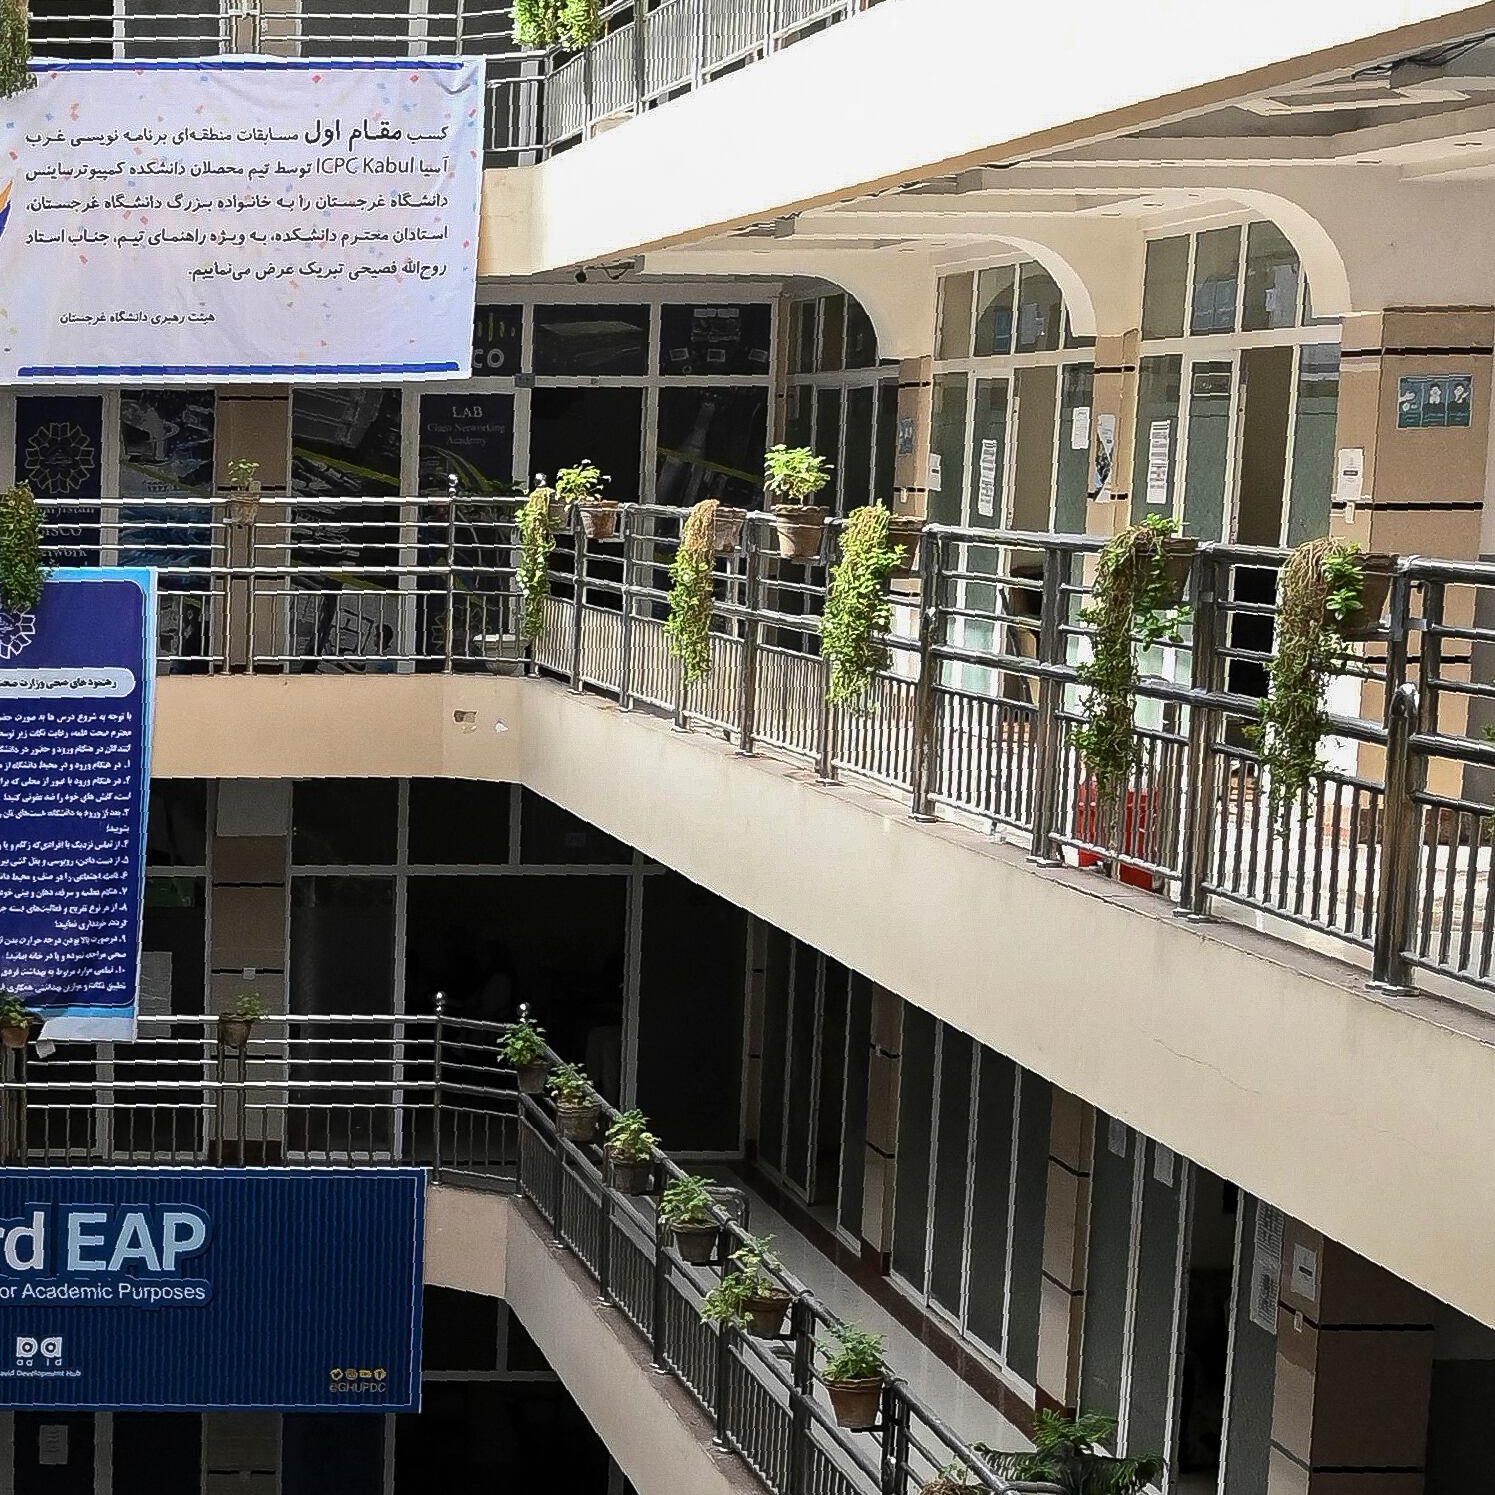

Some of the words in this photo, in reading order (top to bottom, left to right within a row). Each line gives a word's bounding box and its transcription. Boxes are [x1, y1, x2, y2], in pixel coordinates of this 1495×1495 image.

[26, 130, 65, 146] غرب
[71, 130, 118, 147] نویسی
[123, 128, 167, 149] برنامه
[237, 128, 298, 145] مسابقات
[305, 119, 340, 147] اول
[349, 119, 401, 152] مقام
[407, 126, 448, 144] کسب
[130, 162, 185, 175] دانشکده
[191, 161, 243, 177] محصلان
[248, 163, 270, 181] تیم
[274, 161, 312, 178] توسط
[317, 157, 358, 174] ICPC
[363, 157, 414, 173] Kabul
[420, 156, 449, 177] آسیا
[104, 194, 162, 214] دانشگاه
[167, 193, 212, 212] بزرگ
[218, 195, 271, 212] خانواده
[277, 198, 294, 212] به
[299, 195, 310, 211] را
[316, 194, 386, 211] غرجستان
[391, 192, 447, 207] دانشگاه
[26, 229, 64, 244] استاد
[68, 227, 109, 246] جناب
[148, 228, 206, 245] راهنمای
[210, 230, 245, 245] ویژه
[250, 232, 266, 245] به
[341, 230, 388, 247] محترم
[393, 226, 447, 243] استادان
[256, 263, 294, 280] عرض
[299, 261, 344, 279] تبریک
[349, 261, 397, 280] فصیحی
[60, 312, 106, 325] غرجستان
[110, 311, 147, 322] دانشگاه
[151, 315, 185, 325] رهبری
[453, 407, 482, 417] LAB
[67, 1212, 208, 1272] EAP
[22, 1283, 113, 1299] Academic
[119, 1282, 205, 1302] Purposes
